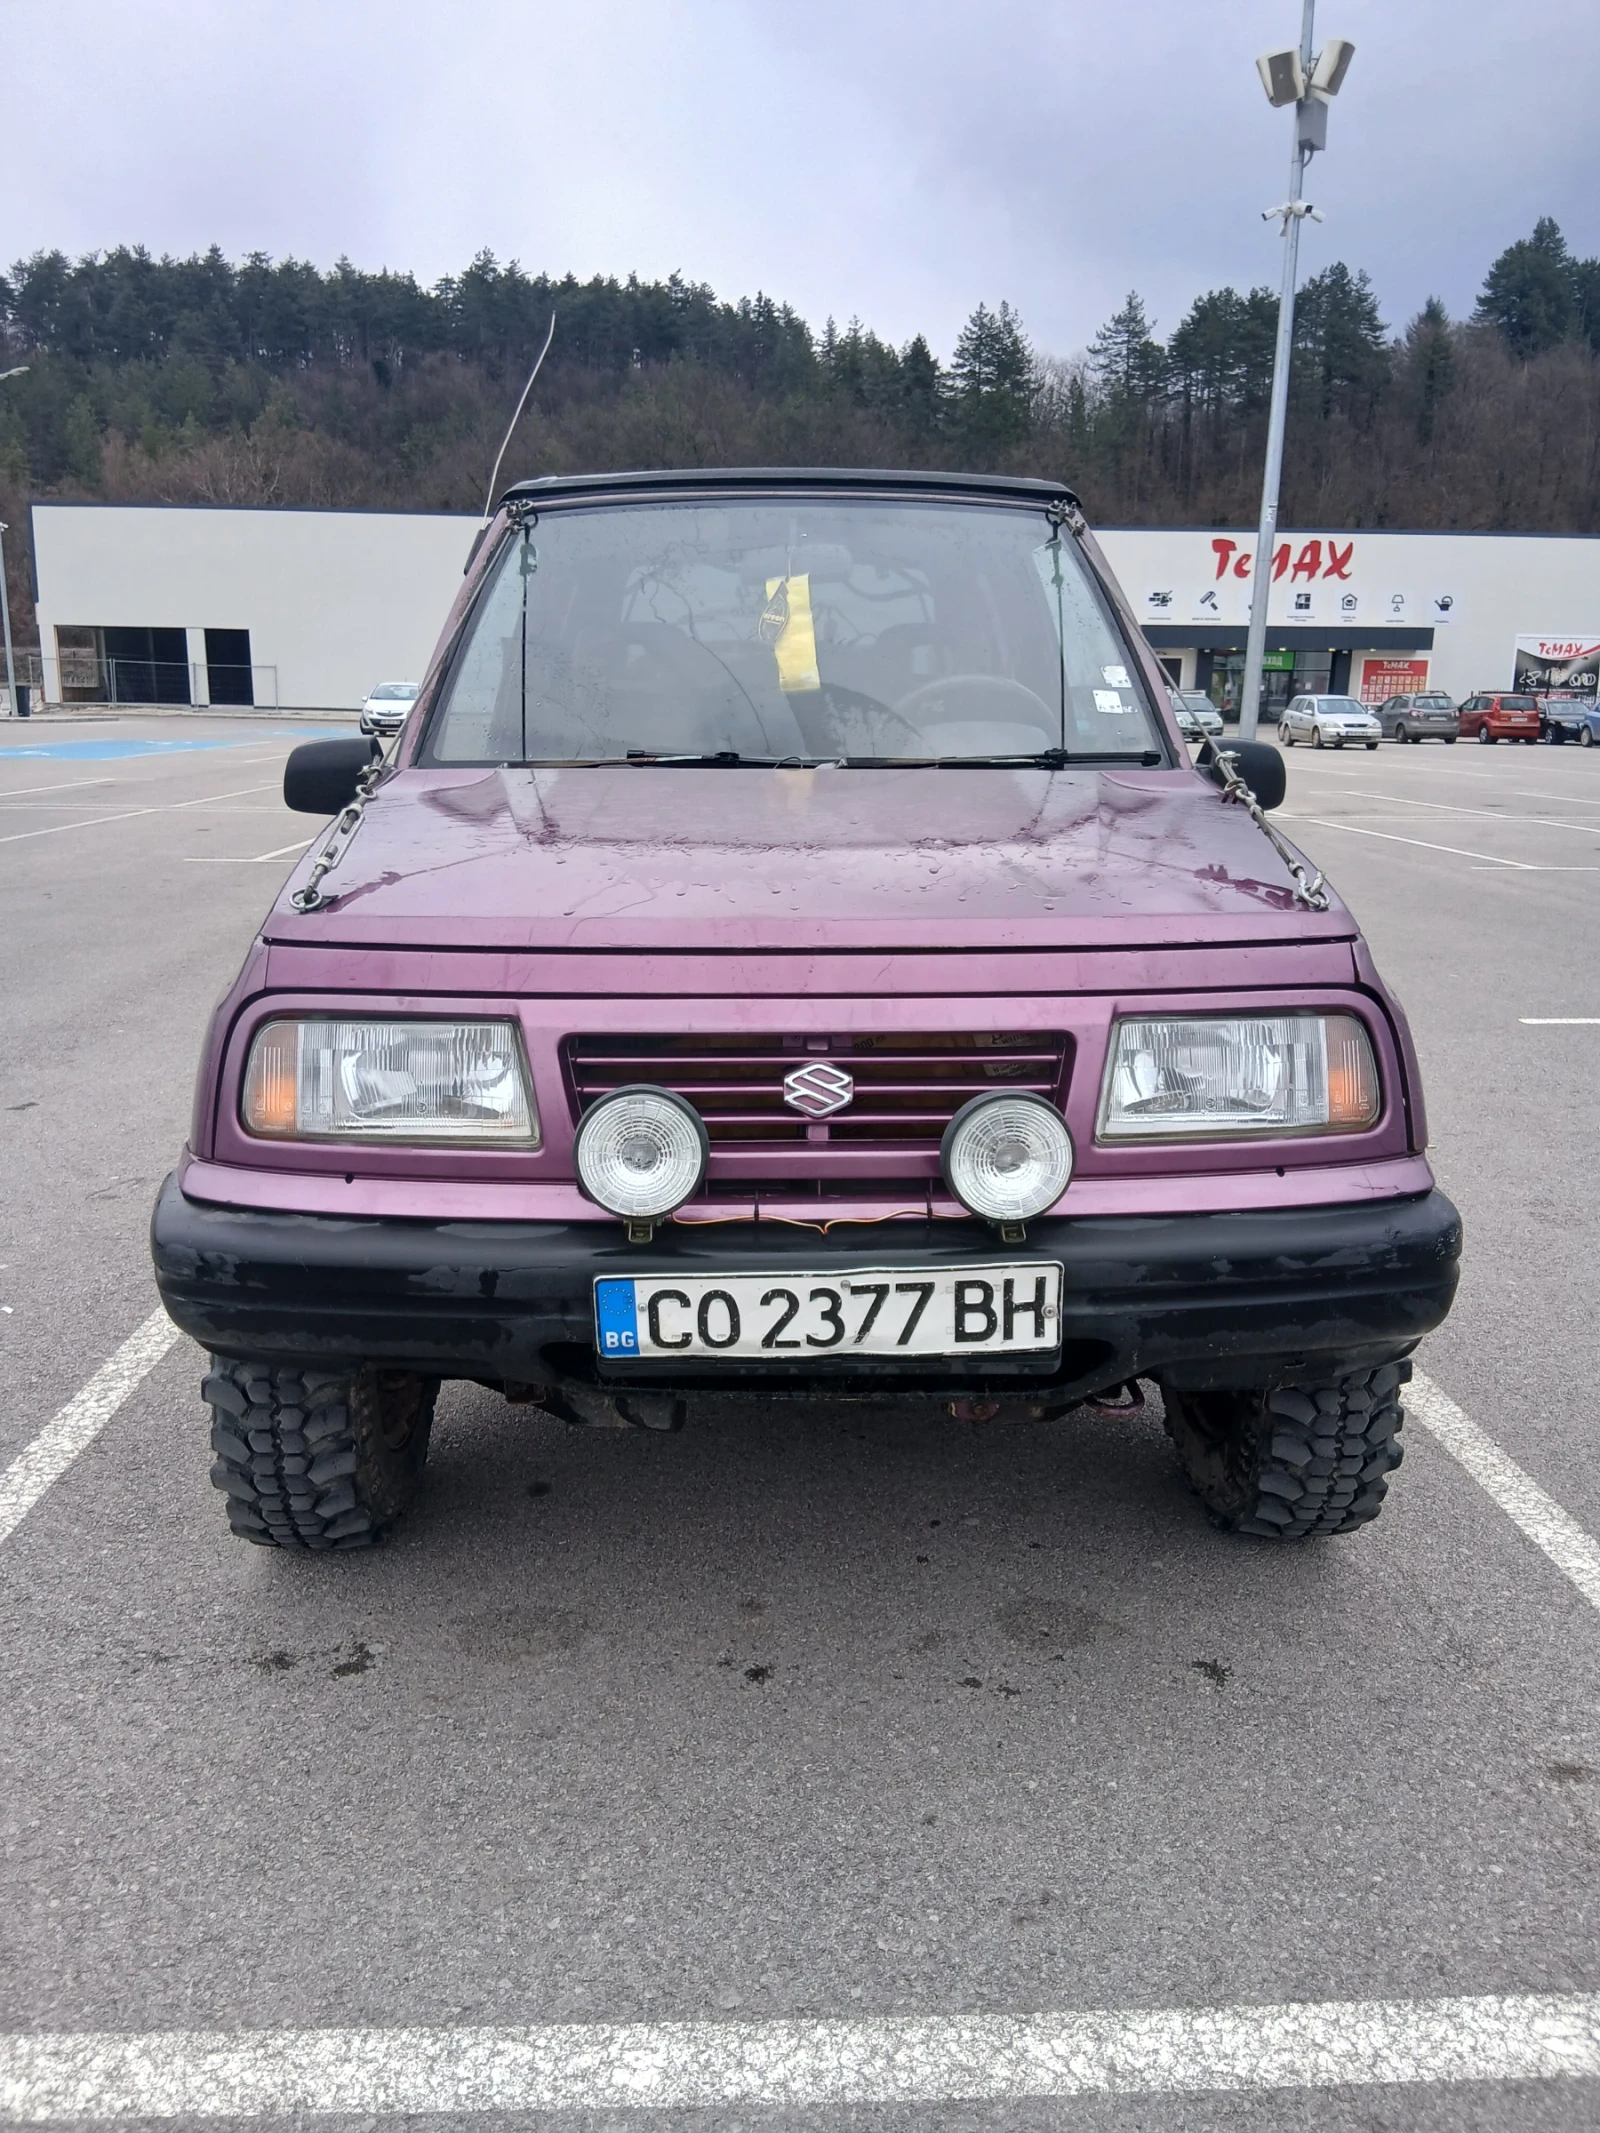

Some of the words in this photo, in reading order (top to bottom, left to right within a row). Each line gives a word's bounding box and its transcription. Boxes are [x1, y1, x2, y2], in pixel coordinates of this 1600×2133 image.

[646, 1288, 741, 1349] CO
[759, 1281, 936, 1349] 2377
[953, 1275, 1047, 1343] BH
[605, 1331, 635, 1348] BG
